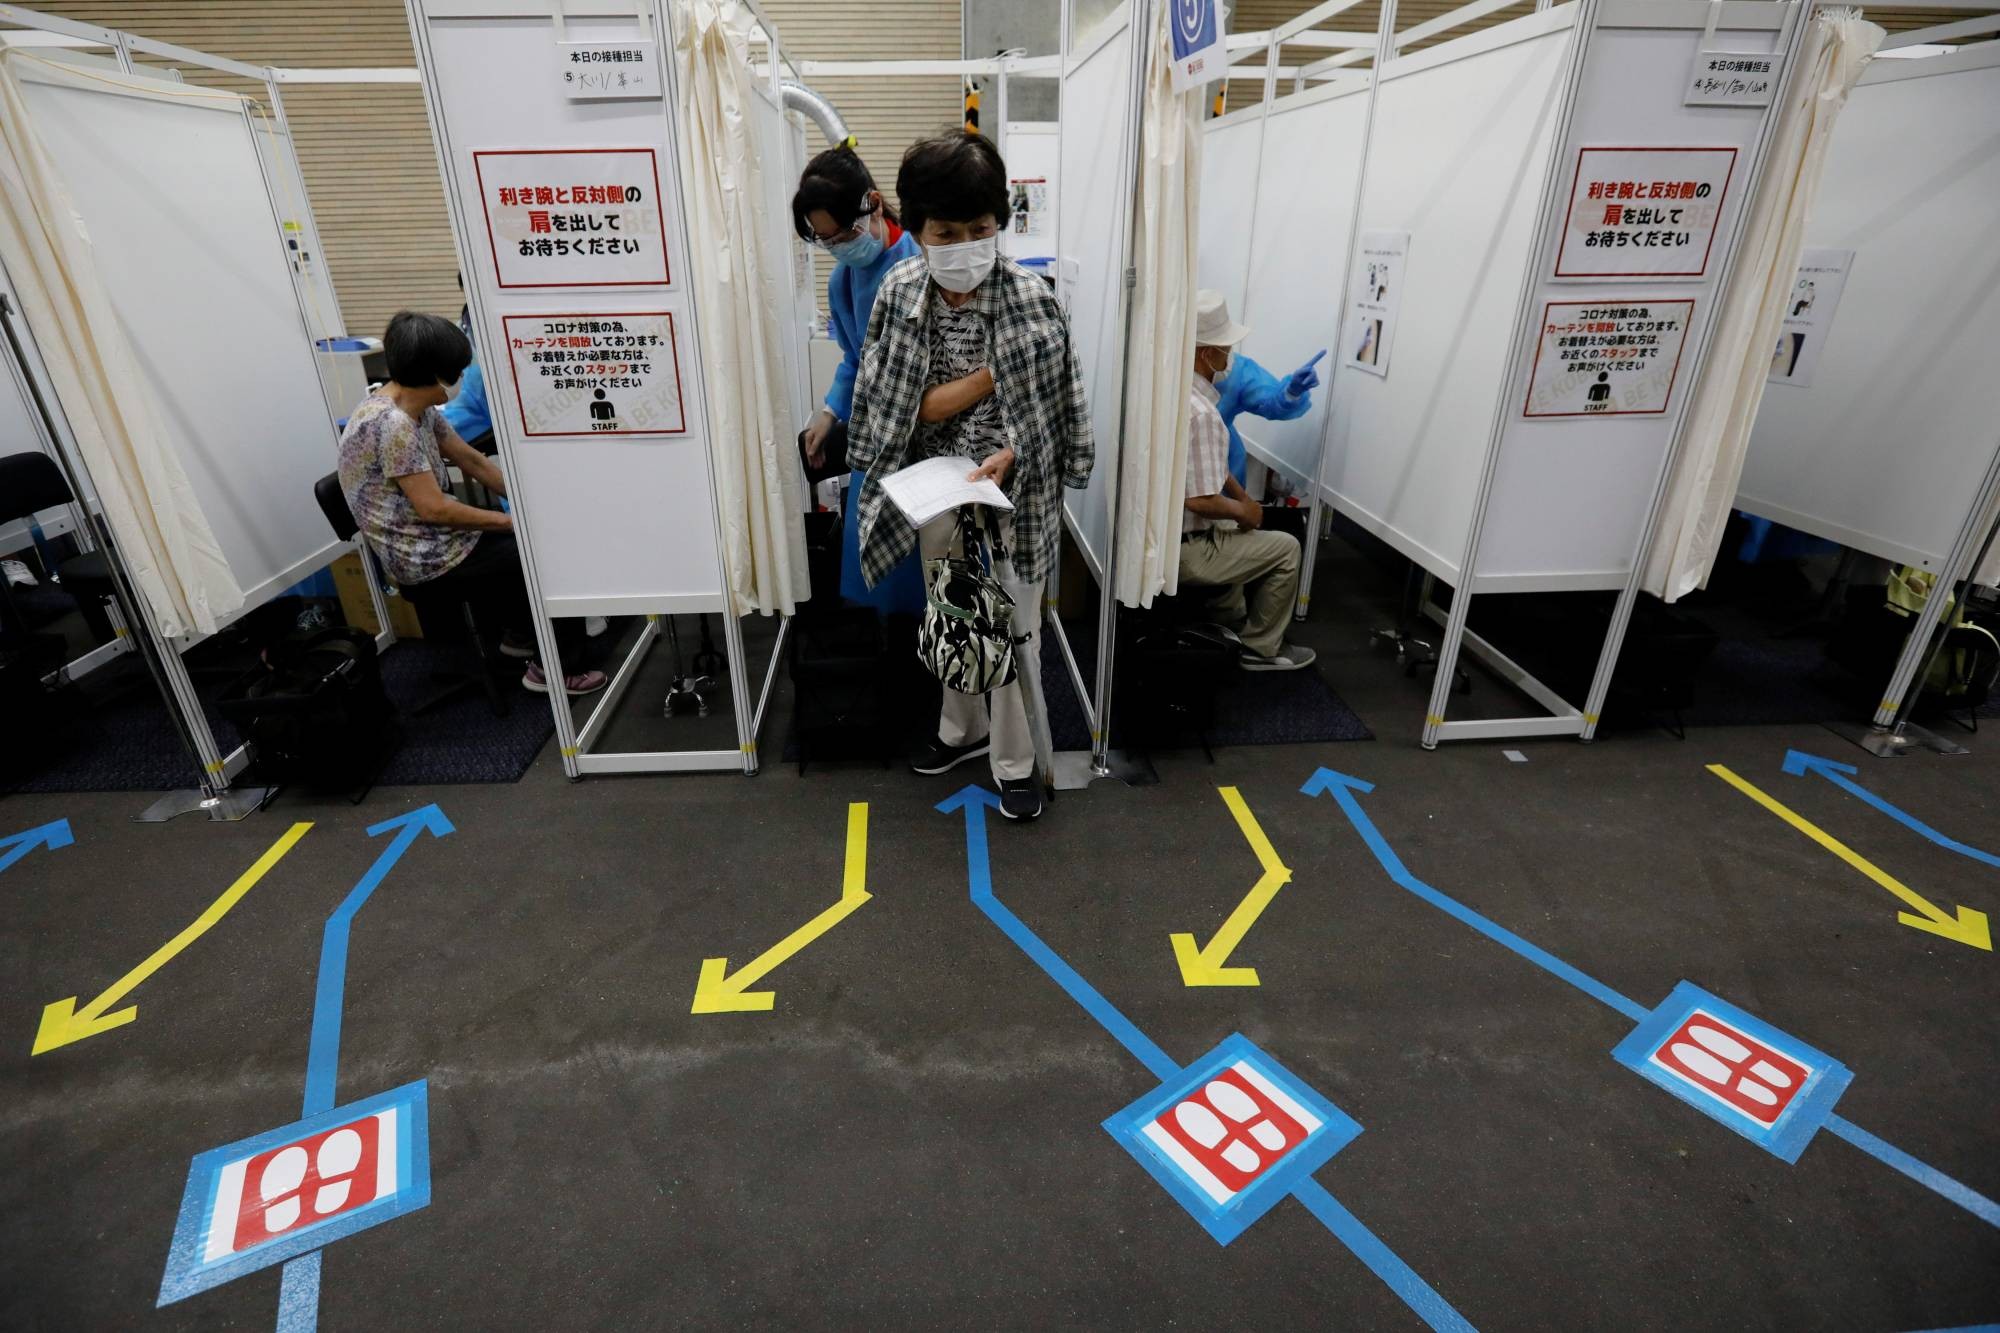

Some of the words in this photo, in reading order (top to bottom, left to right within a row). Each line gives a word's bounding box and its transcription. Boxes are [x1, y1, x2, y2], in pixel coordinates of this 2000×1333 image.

[569, 50, 643, 63] 本日の接種担当
[1708, 60, 1771, 73] 本日の接種担当
[499, 185, 642, 206] 利き腕と反対側の
[1588, 182, 1711, 200] 利き腕と反対側の
[1602, 204, 1683, 226] 肩を出して
[528, 211, 620, 234] 肩を出して
[1585, 231, 1690, 248] お待ちください
[518, 238, 640, 257] お待ちください
[543, 321, 630, 334] コロナ対策の為、
[1546, 321, 1679, 333] カーテンを開放しております。
[512, 335, 666, 349] カーテンを開放しております。
[532, 349, 650, 363] お着替えが必要な方は、
[1560, 347, 1658, 360] お近くのスタッフまで
[540, 363, 652, 376] お近くのスタッフまで
[1567, 361, 1645, 373] お声がけください
[553, 377, 642, 390] お声がけください
[1584, 404, 1609, 412] STAFF
[591, 423, 618, 431] STAFF
